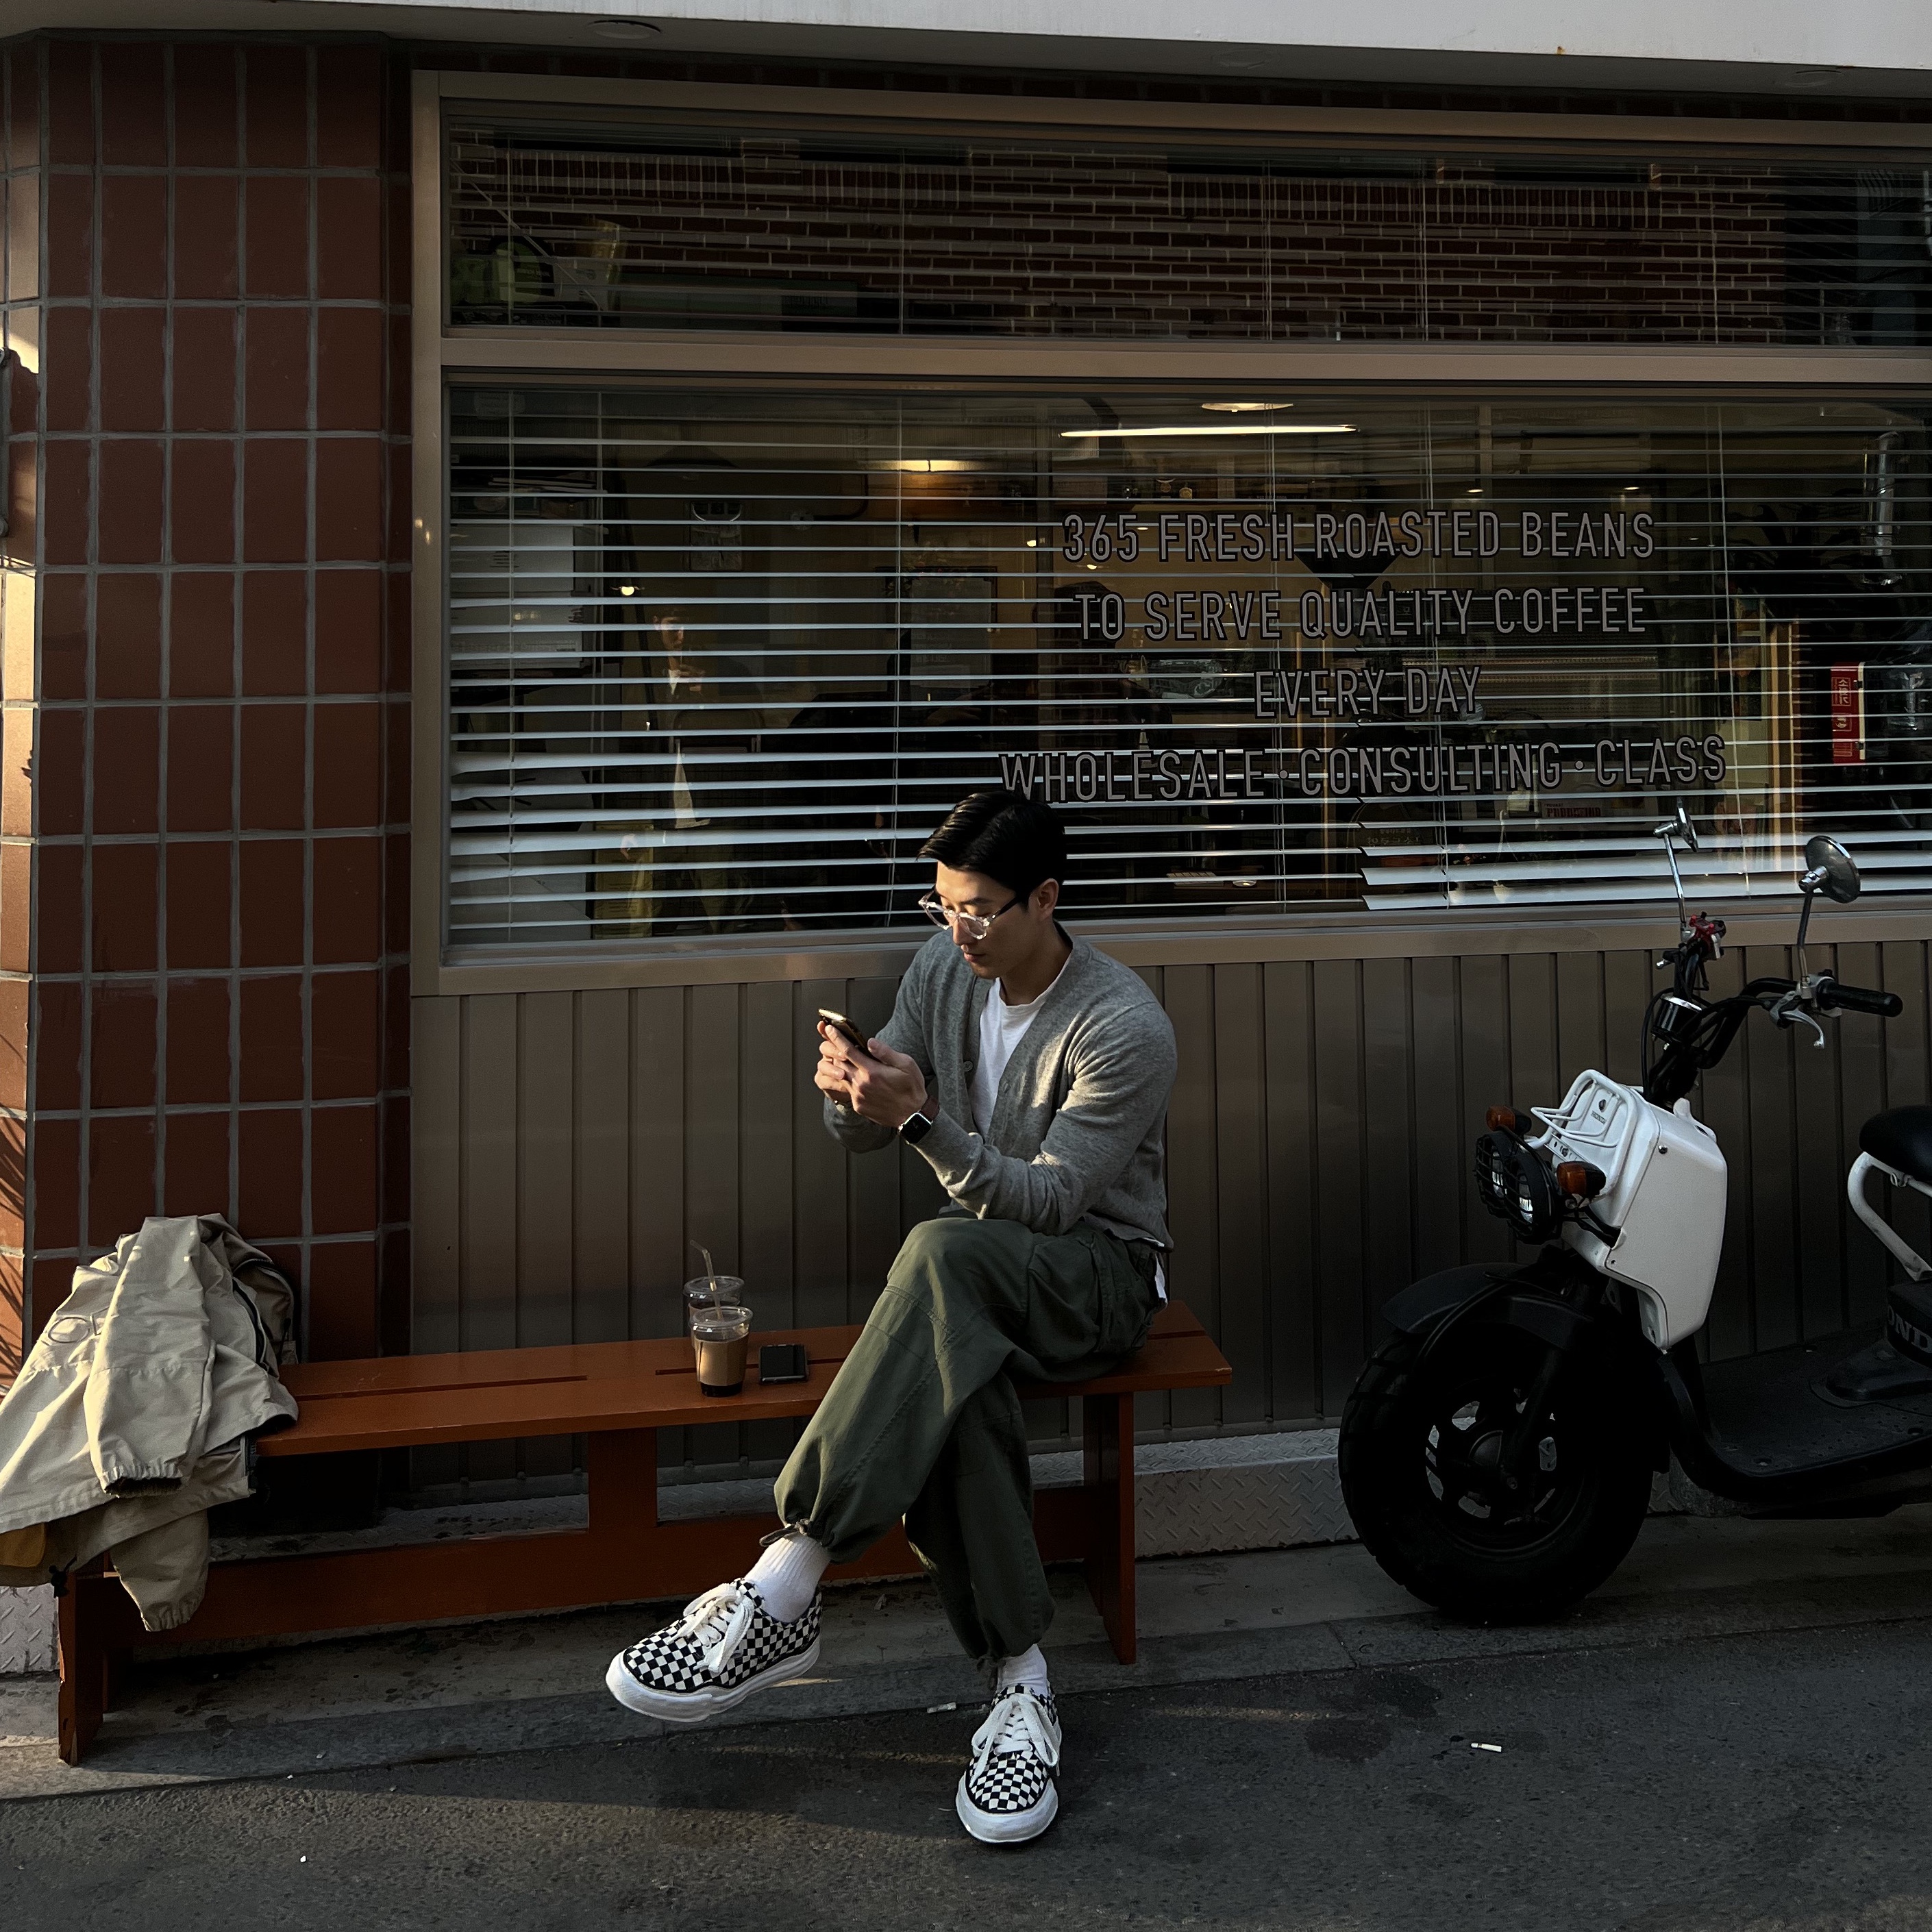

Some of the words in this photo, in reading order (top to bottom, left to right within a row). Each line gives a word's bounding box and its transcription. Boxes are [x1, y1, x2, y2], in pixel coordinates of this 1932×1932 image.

[1064, 513, 1138, 562] 365
[1159, 512, 1294, 562] FRESH
[1315, 511, 1500, 560] ROASTED
[1521, 512, 1655, 558] BEANS
[1074, 592, 1125, 641] TO
[1145, 591, 1282, 641] SERVE
[1300, 589, 1473, 640] QUALITY
[1494, 587, 1646, 634] COFFEE
[1254, 669, 1385, 718] EVERY
[1407, 667, 1481, 715] DAY
[1000, 750, 1266, 801] WHOLESALE
[1300, 742, 1562, 797] CONSULTING
[1595, 735, 1726, 786] CLASS
